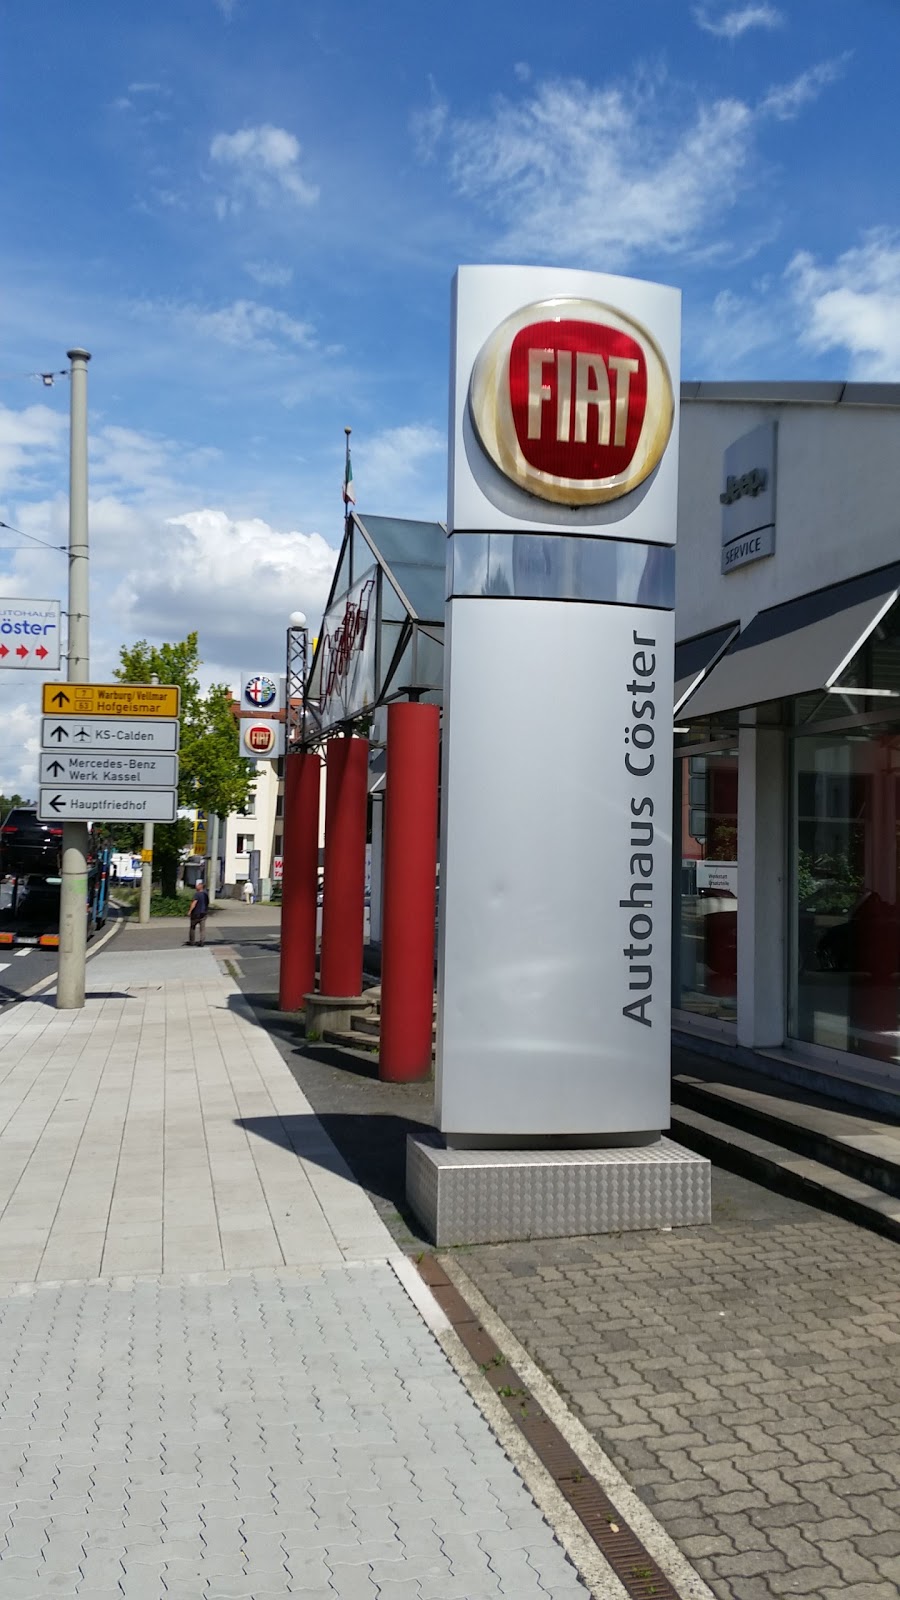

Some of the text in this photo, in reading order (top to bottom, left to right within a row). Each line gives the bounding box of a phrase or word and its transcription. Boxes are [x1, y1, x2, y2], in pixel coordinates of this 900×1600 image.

[527, 347, 639, 448] FIAT
[725, 537, 762, 565] SERVICE
[1, 618, 57, 636] öster
[97, 701, 161, 714] Hofgeismar
[95, 729, 154, 741] KS-Calden
[251, 731, 271, 746] FIAT
[69, 758, 156, 769] Mercedes-Benz
[69, 770, 141, 782] Werk Kassel
[70, 799, 147, 811] Hauptfriedhof
[619, 629, 657, 1028] Autohaus Cöster
